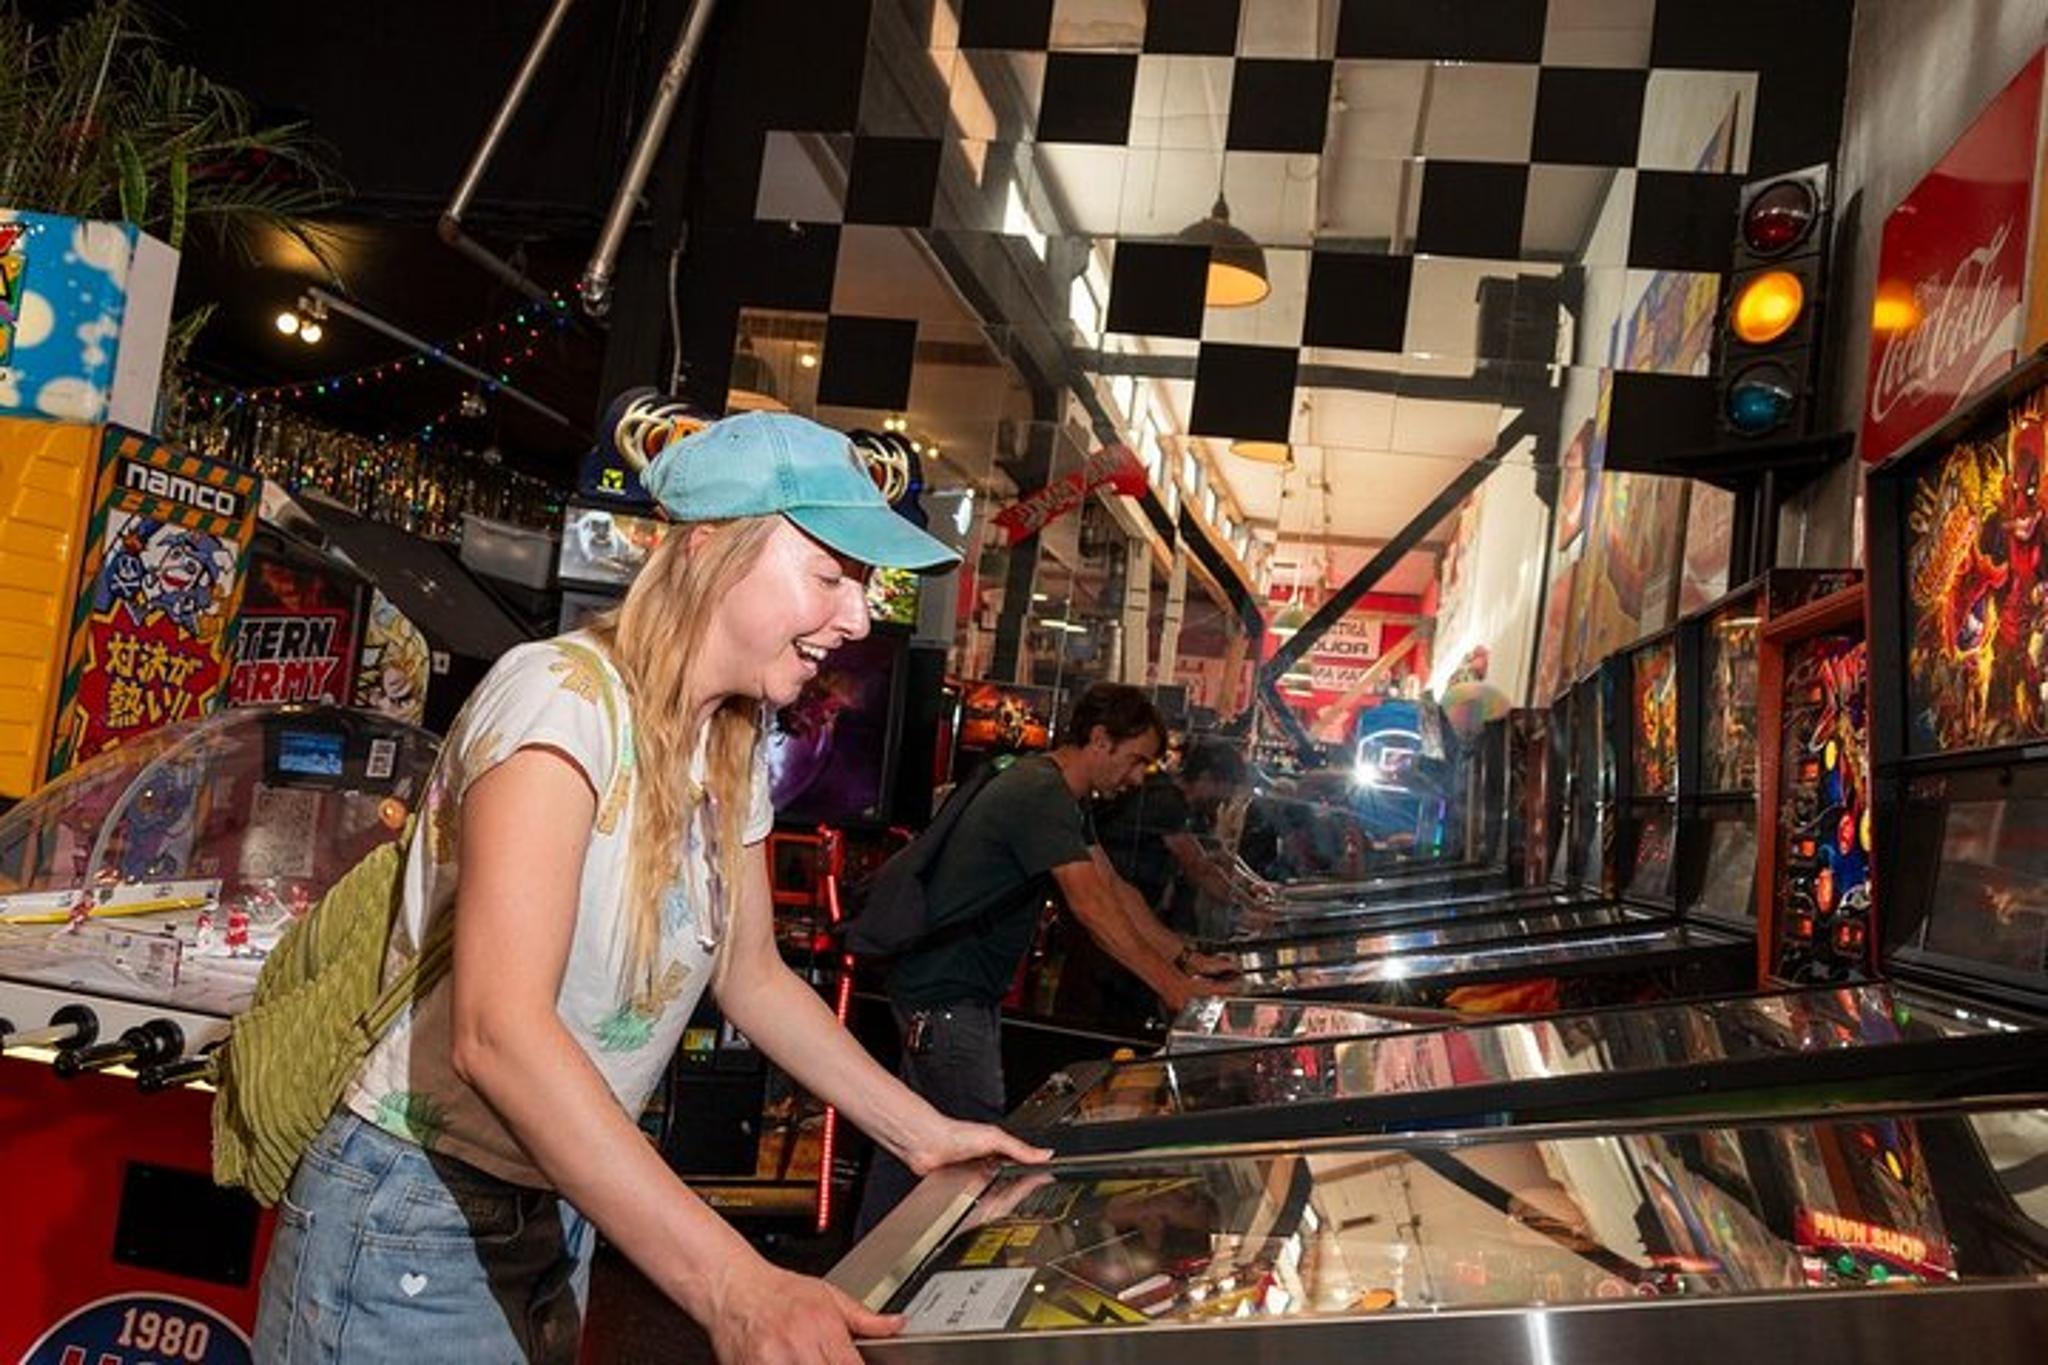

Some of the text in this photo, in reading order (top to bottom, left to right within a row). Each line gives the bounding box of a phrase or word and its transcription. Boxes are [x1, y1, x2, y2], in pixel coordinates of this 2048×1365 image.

[125, 462, 235, 516] namco
[105, 632, 202, 686] 対決が
[227, 658, 339, 704] ARMY
[1812, 1210, 1927, 1264] PAWN SHOP
[117, 1307, 211, 1361] 1980
